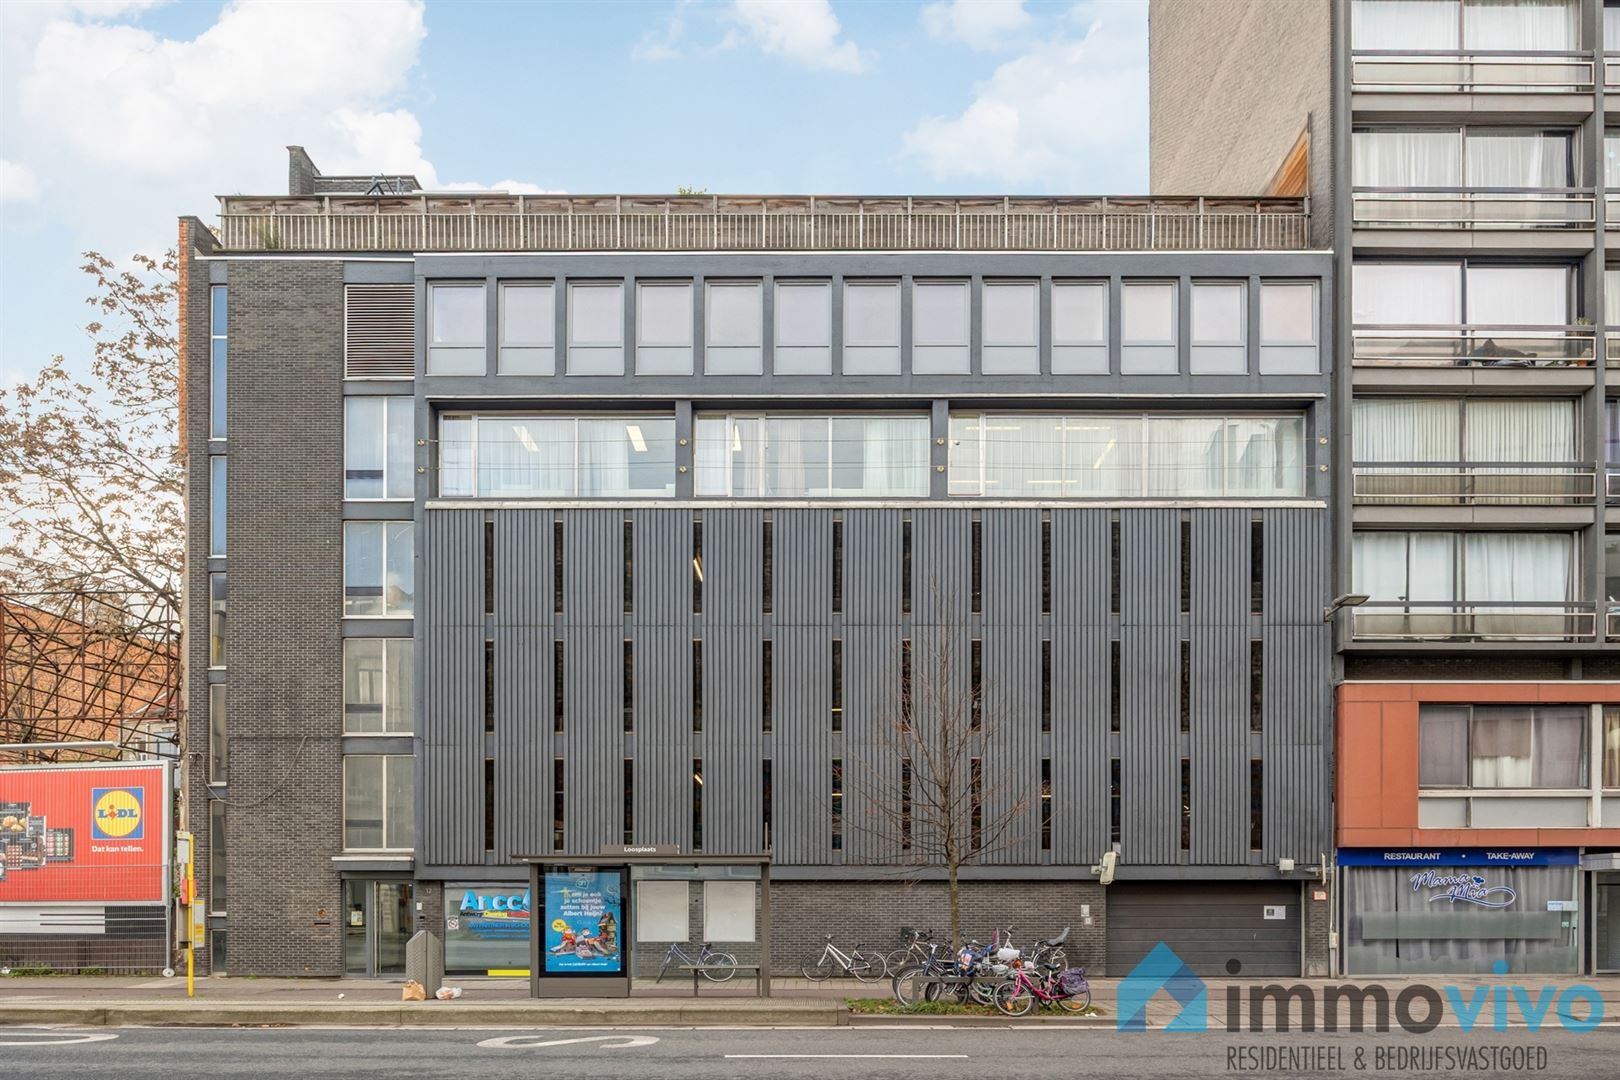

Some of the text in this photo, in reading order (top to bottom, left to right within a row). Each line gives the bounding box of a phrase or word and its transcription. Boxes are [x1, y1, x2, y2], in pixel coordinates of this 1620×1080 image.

[91, 845, 144, 853] Dat kan tellen.
[623, 846, 657, 854] Loosplaats
[1383, 852, 1535, 860] RESTAURANT TAKE-AWAY
[1410, 870, 1470, 891] Mama
